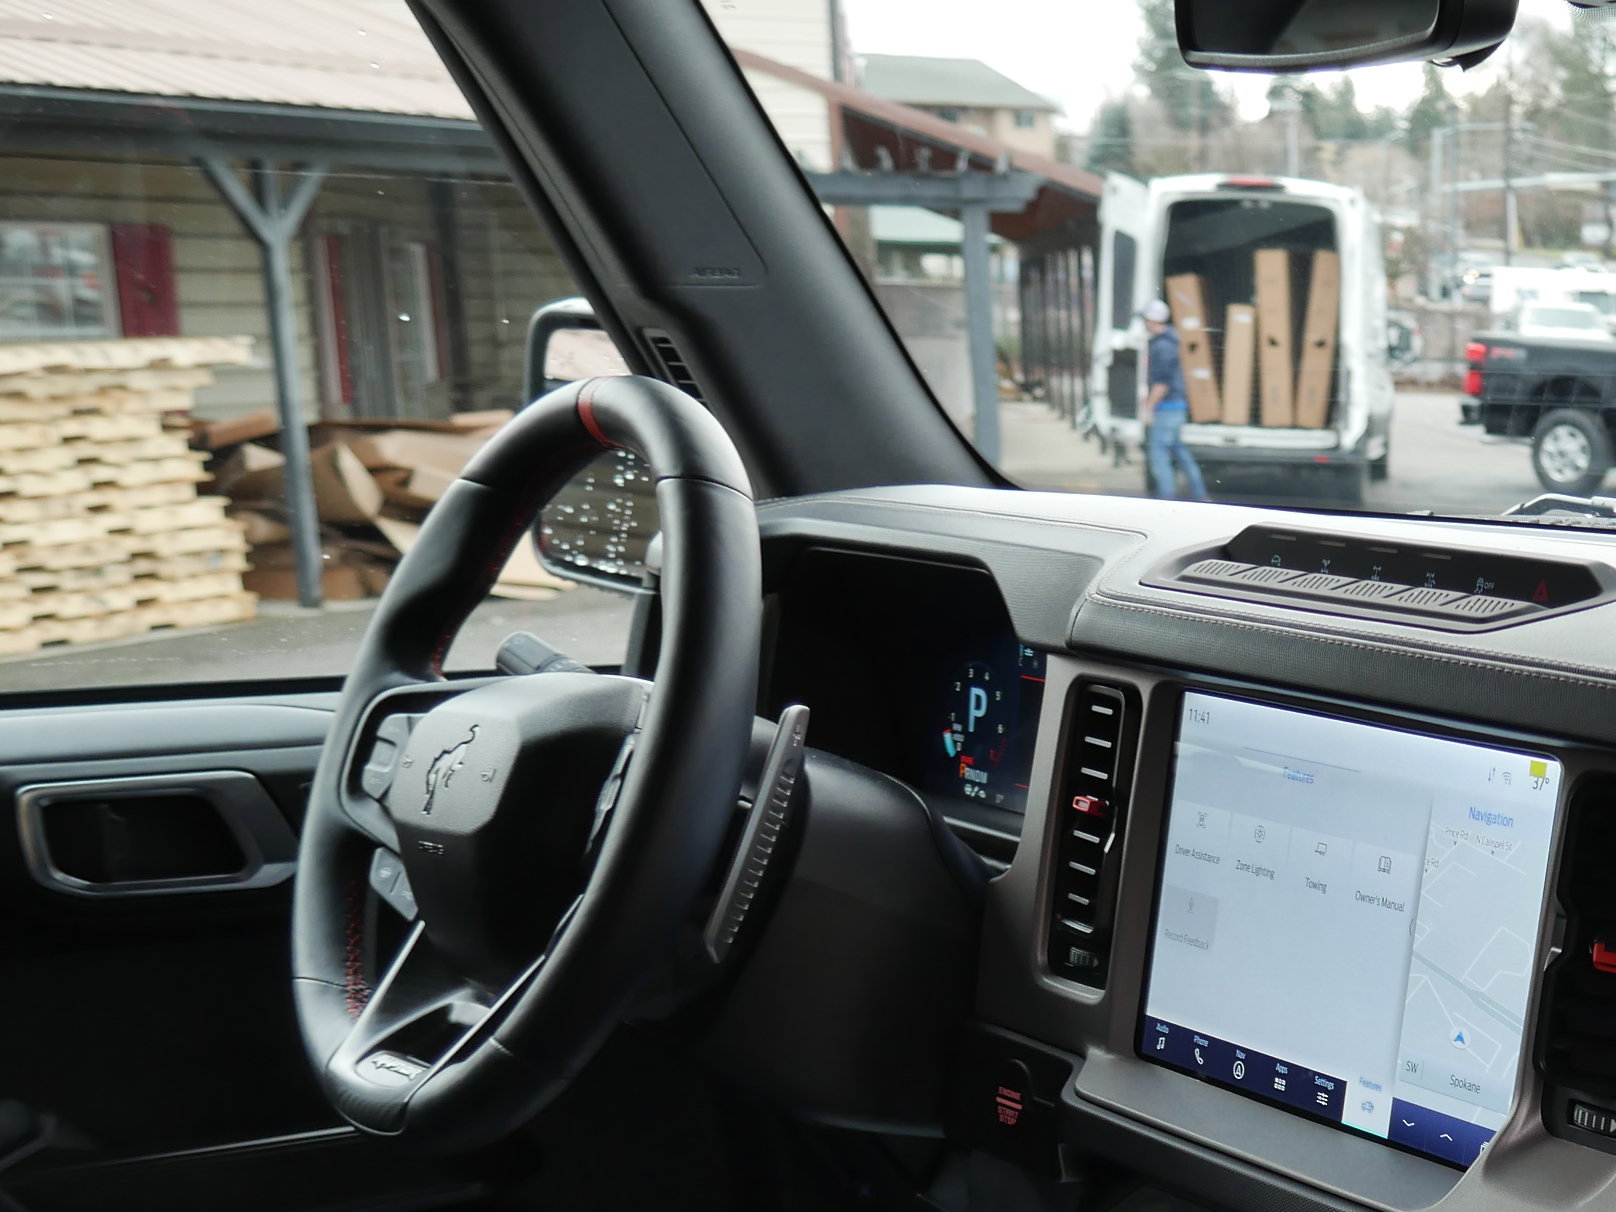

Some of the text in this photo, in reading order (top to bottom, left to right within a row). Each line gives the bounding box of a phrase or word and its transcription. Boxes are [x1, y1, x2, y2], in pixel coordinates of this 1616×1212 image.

[967, 686, 988, 733] P
[1188, 708, 1210, 725] 11:41
[1468, 806, 1514, 828] Navigation
[1174, 843, 1221, 865] Driver Assistance
[1235, 859, 1275, 881] Zone Lighting
[1305, 876, 1328, 894] Towing
[1355, 890, 1406, 913] Owner's Manual
[1155, 1022, 1170, 1035] Audio
[1193, 1034, 1209, 1048] Phone
[1235, 1049, 1246, 1060] Nav
[1275, 1062, 1288, 1075] Apps
[1405, 1060, 1419, 1074] SW
[1314, 1075, 1335, 1091] Settings
[1359, 1076, 1383, 1093] Features
[1449, 1074, 1481, 1095] Spokane
